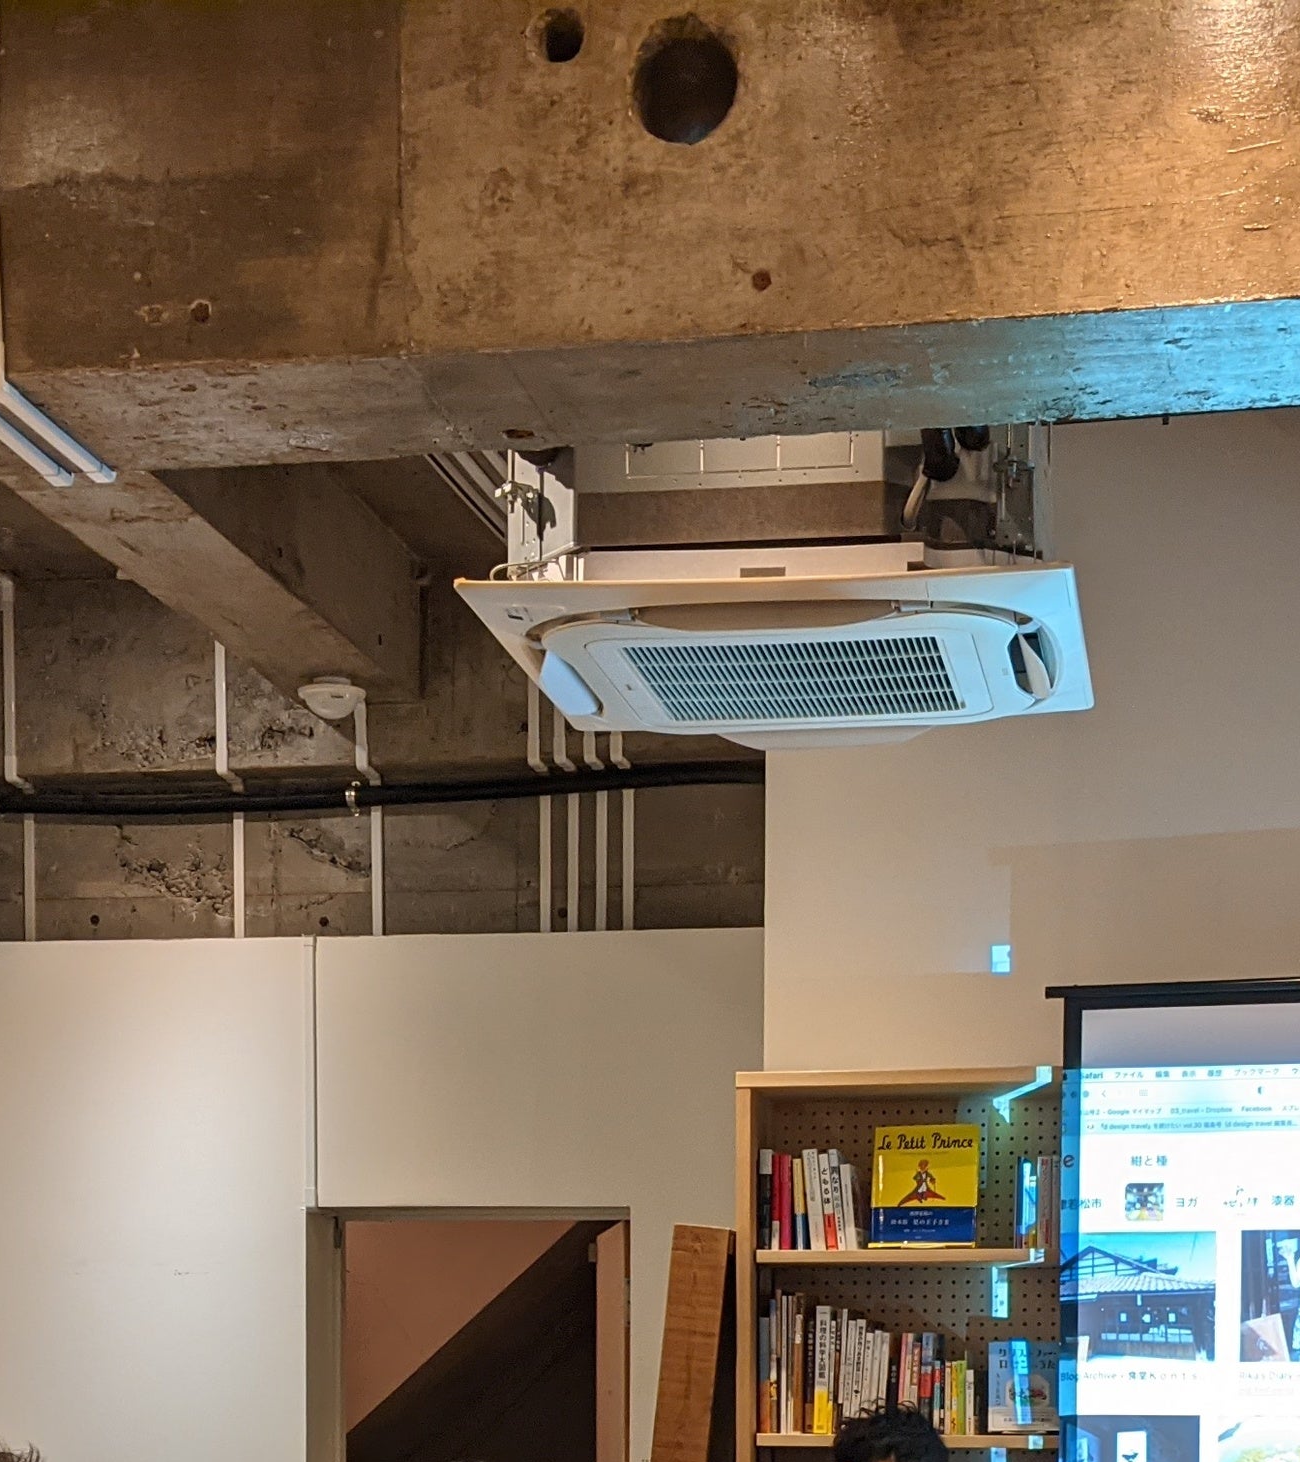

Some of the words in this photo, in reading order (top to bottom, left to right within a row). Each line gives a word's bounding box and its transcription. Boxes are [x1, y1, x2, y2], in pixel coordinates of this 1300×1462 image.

[1114, 1067, 1144, 1079] ファイル
[1233, 1067, 1280, 1078] ブックマーク
[877, 1135, 892, 1150] Le
[897, 1133, 926, 1150] Petit
[931, 1132, 973, 1149] Prince
[1176, 1197, 1198, 1208] ヨガ
